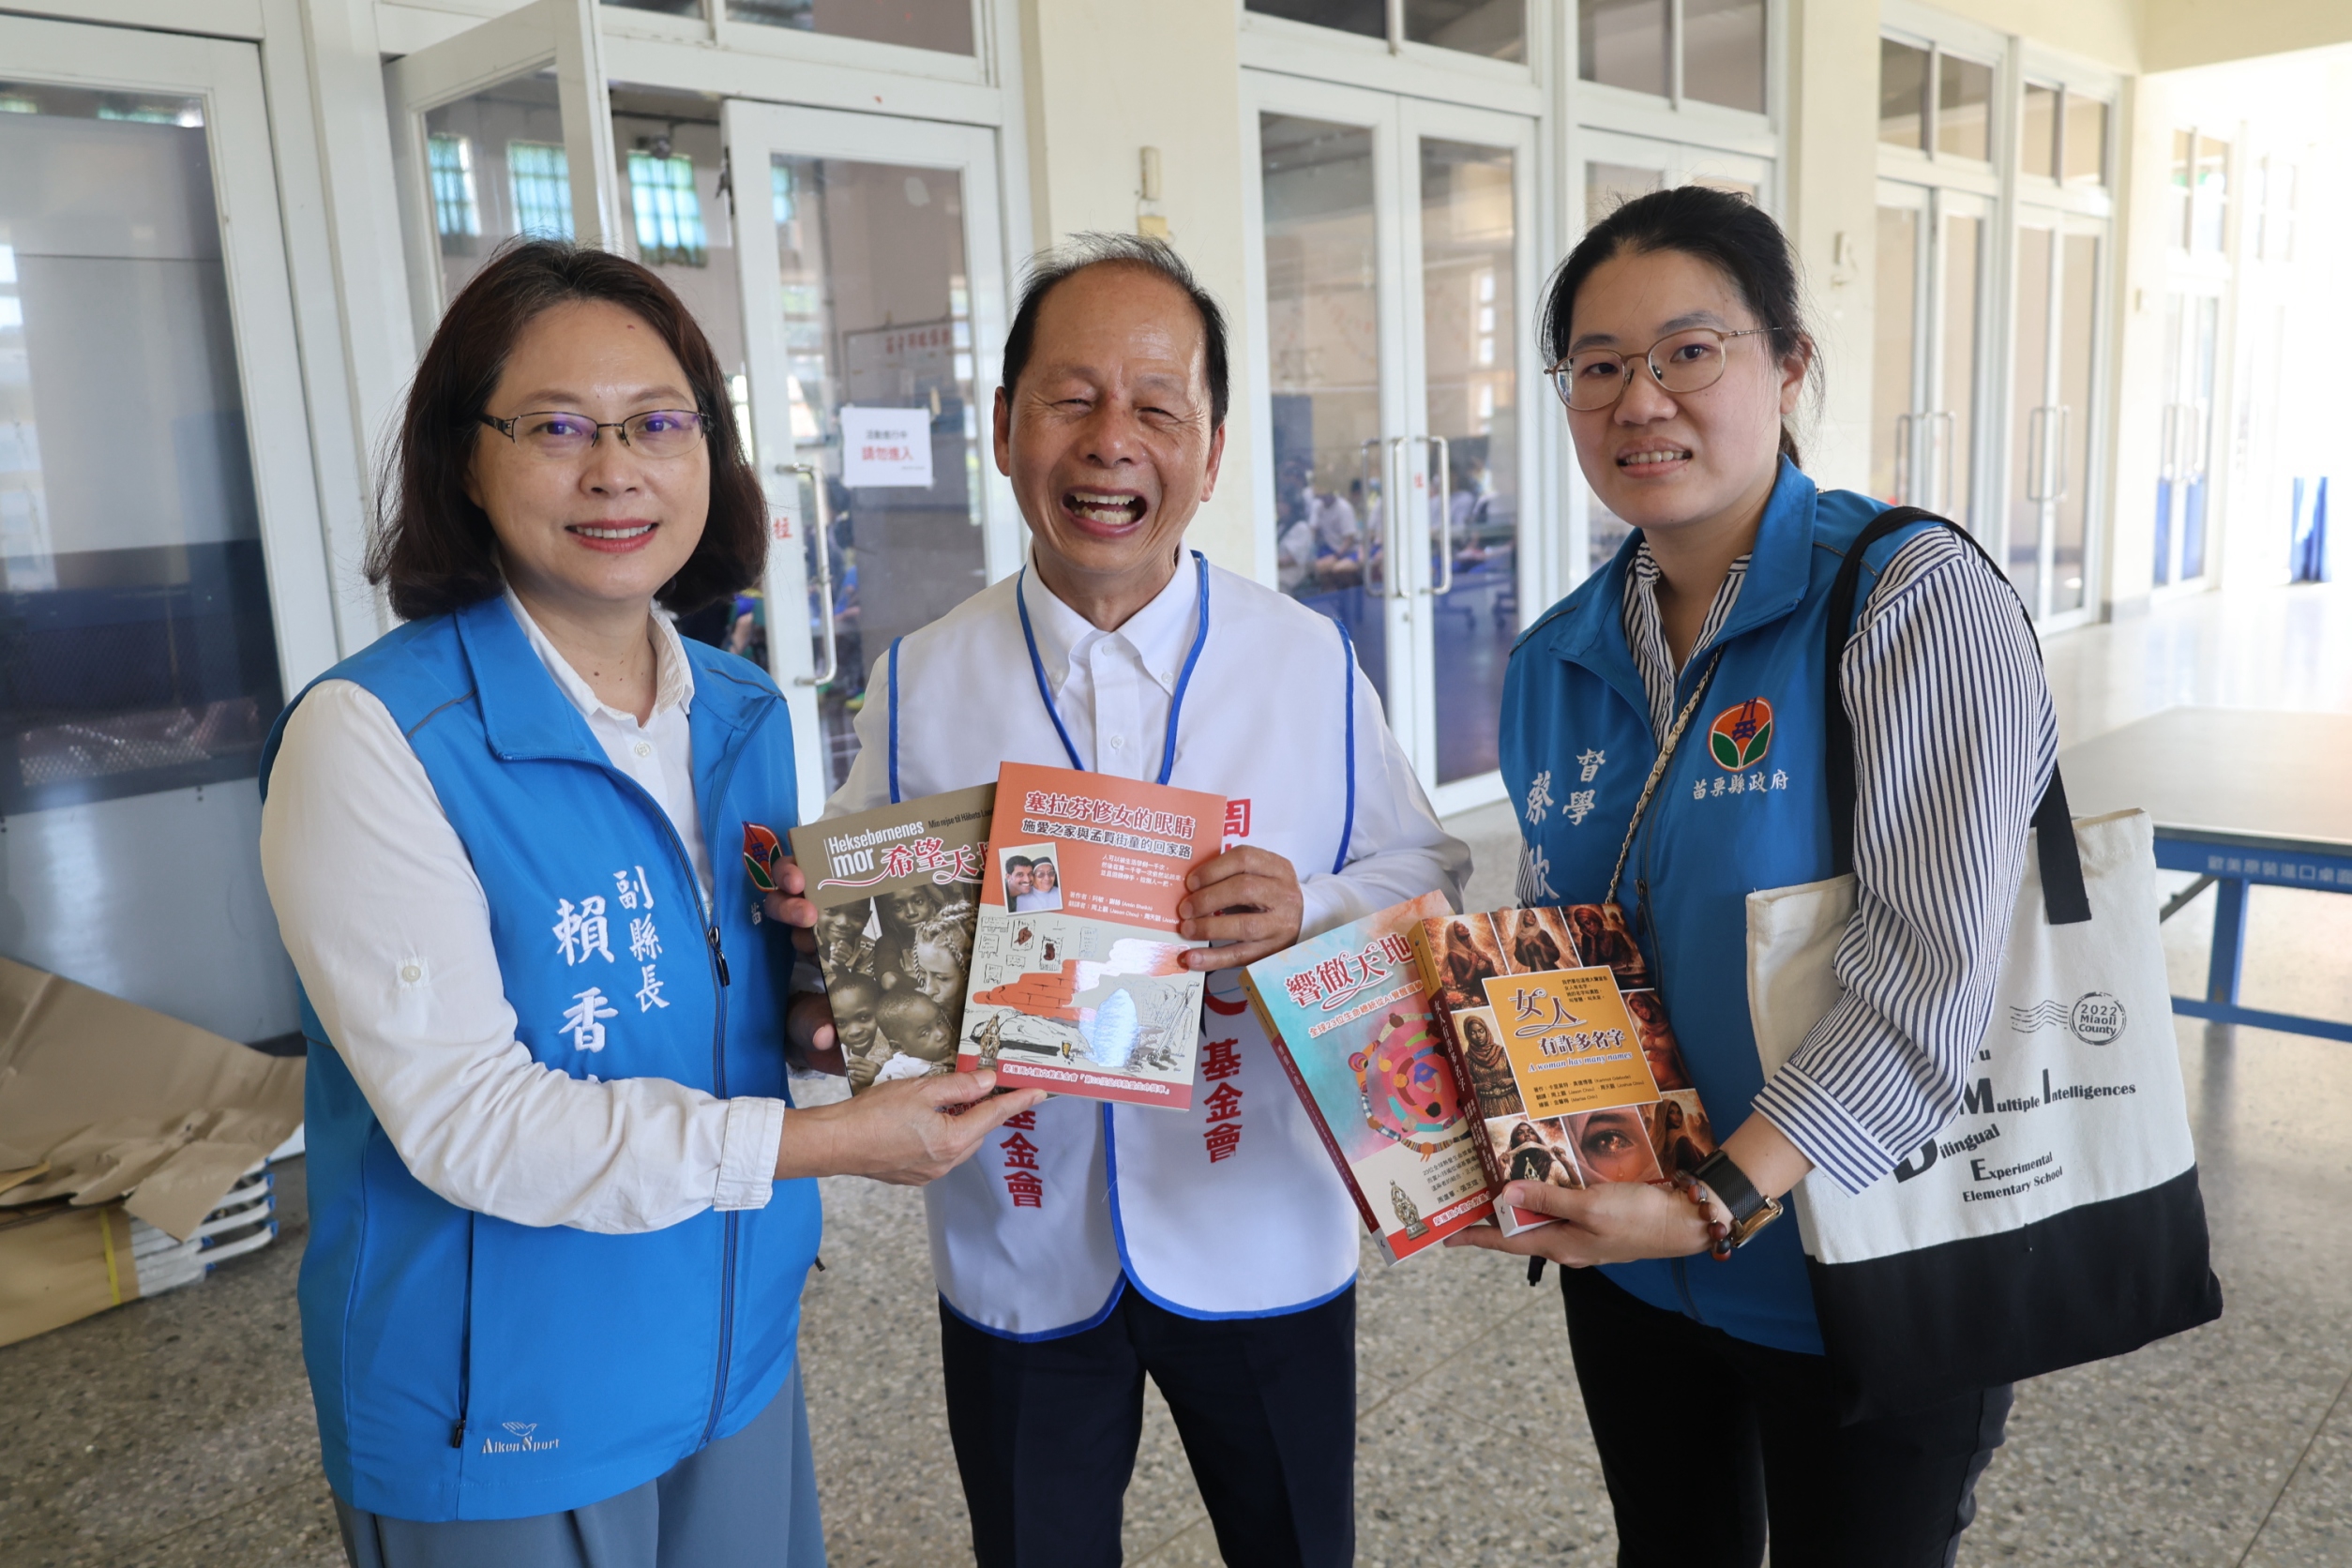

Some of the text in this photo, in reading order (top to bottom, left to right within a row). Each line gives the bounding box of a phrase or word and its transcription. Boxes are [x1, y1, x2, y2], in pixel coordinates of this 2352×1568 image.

[862, 446, 913, 461] 請勿進入
[1693, 769, 1789, 800] 苗栗縣政府
[928, 820, 941, 829] Min
[941, 817, 955, 828] rejse
[1024, 791, 1196, 840] 塞拉芬修女的眼睛
[829, 821, 925, 855] Heksebørnenes
[1021, 818, 1193, 859] 施愛之家與孟買街童的回家路
[833, 848, 875, 878] mor
[612, 866, 671, 1013] 副縣長
[551, 896, 619, 1053] 賴香
[1508, 988, 1586, 1036] 女人
[2080, 1004, 2118, 1016] 2022
[2080, 1015, 2117, 1026] Miaoli
[1538, 1029, 1625, 1056] 有許多名字
[2078, 1023, 2117, 1036] County
[1528, 1051, 1634, 1073] A woman has many names
[1201, 1038, 1244, 1163] 基金會
[1959, 1068, 2136, 1115] Multiple Intelligences
[1970, 1152, 2053, 1182] Experimental
[1962, 1166, 2063, 1202] Elementary School
[521, 1436, 560, 1452] Sport
